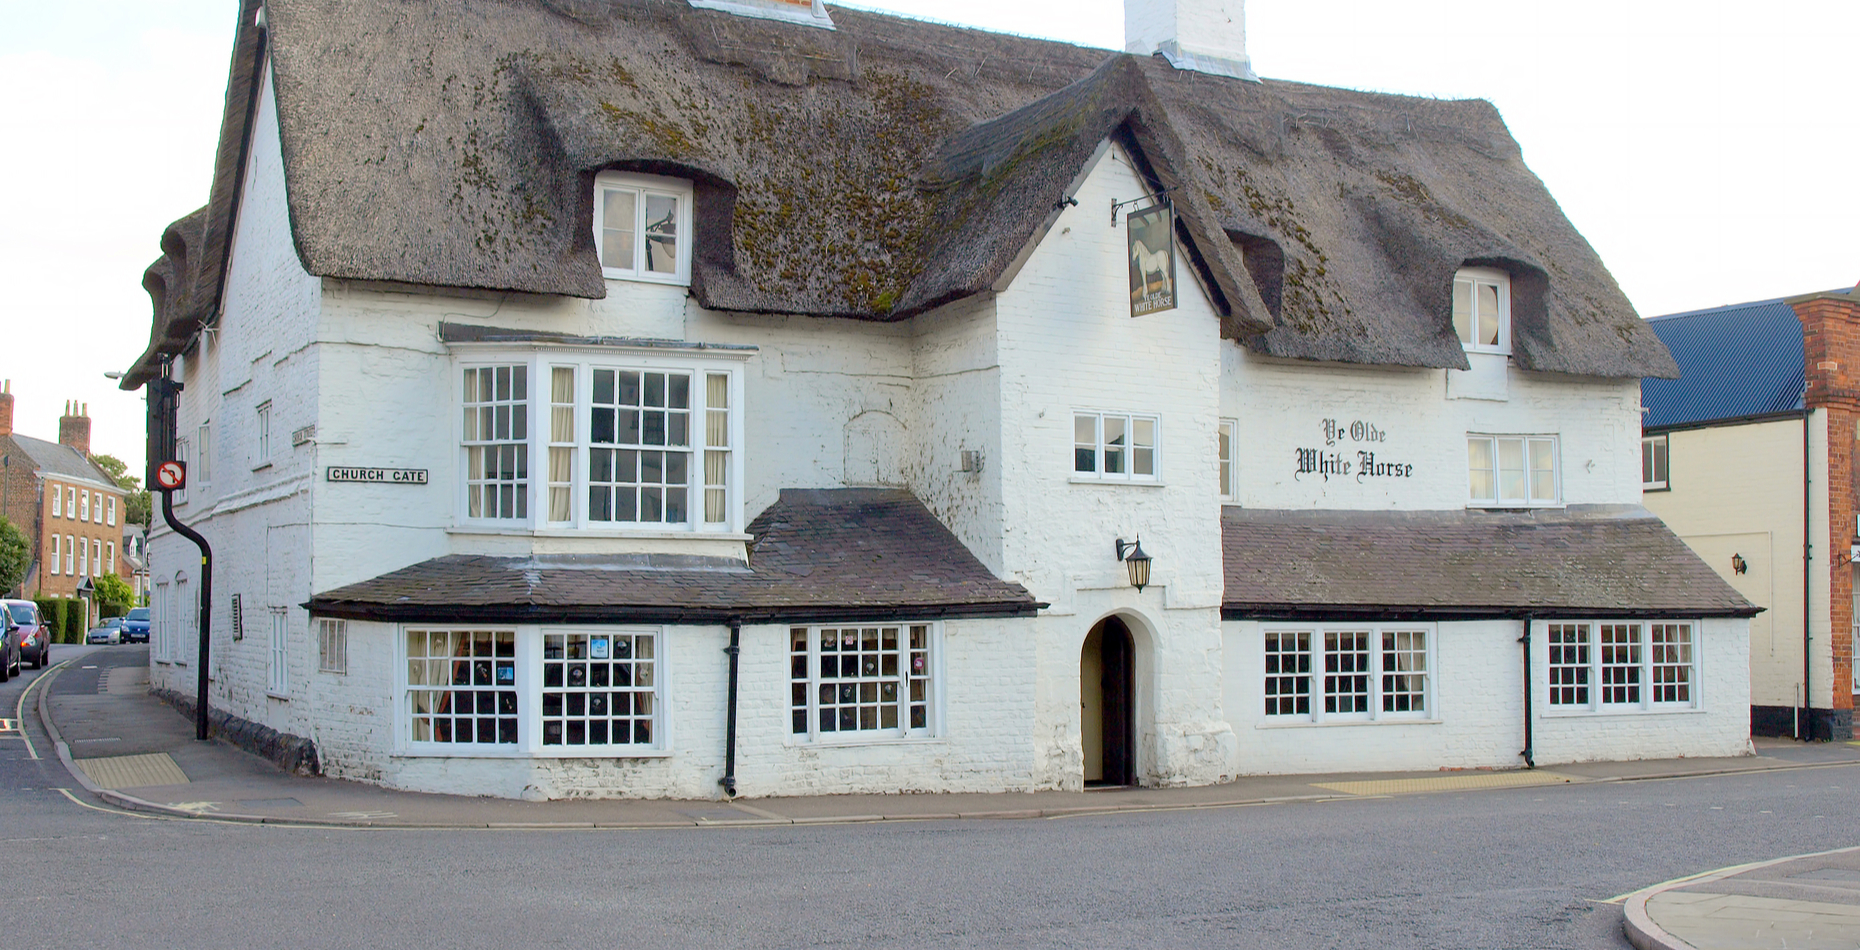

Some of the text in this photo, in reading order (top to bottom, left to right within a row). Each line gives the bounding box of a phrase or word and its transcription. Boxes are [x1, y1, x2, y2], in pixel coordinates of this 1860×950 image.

[1134, 295, 1172, 313] WHITE HORSE
[1322, 418, 1386, 447] Ye Olde
[332, 469, 424, 482] CHURCH GATE
[1295, 447, 1413, 484] White Horse
